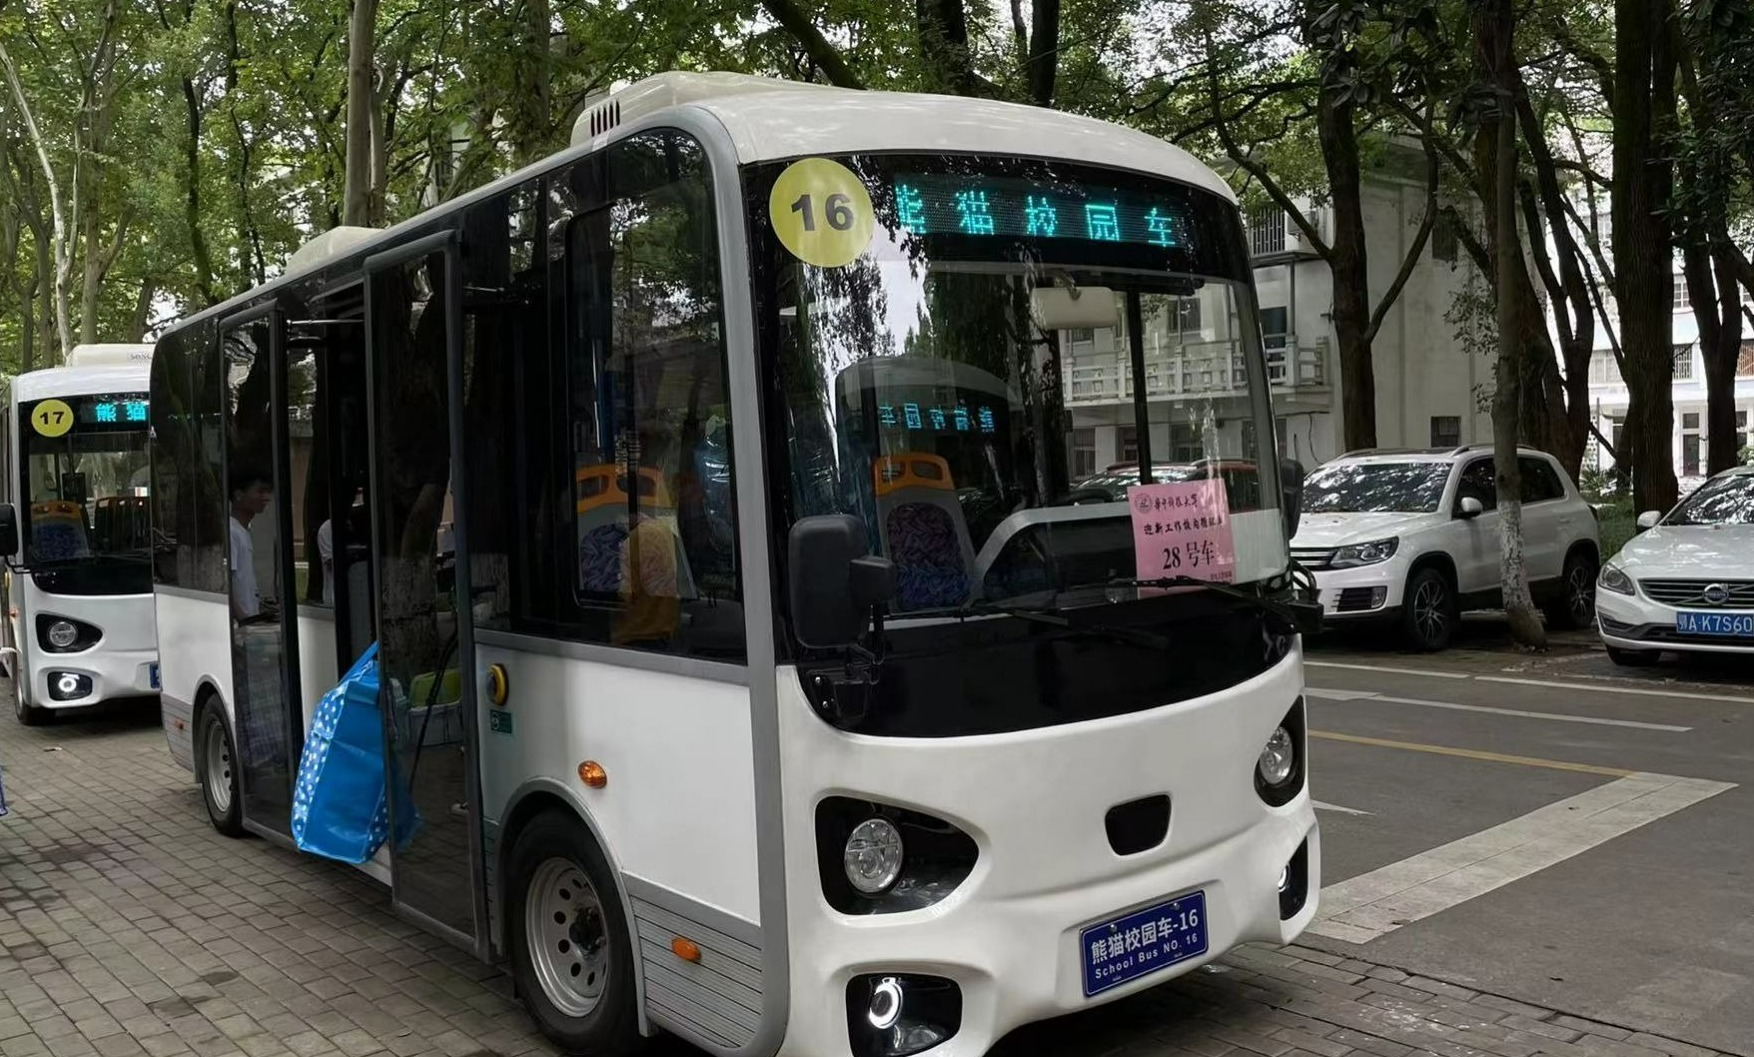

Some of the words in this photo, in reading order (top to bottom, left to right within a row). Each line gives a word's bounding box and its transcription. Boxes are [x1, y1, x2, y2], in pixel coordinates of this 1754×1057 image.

[791, 193, 855, 232] 16
[896, 184, 1175, 247] 熊猫校园车
[40, 411, 65, 425] 17
[95, 401, 147, 422] 熊猫
[1163, 540, 1215, 570] 28号车
[1091, 909, 1199, 965] 熊猫校园车-16
[1095, 956, 1133, 979] School
[1138, 949, 1158, 963] Bus
[1163, 940, 1182, 953] NO.
[1186, 932, 1198, 945] 16
